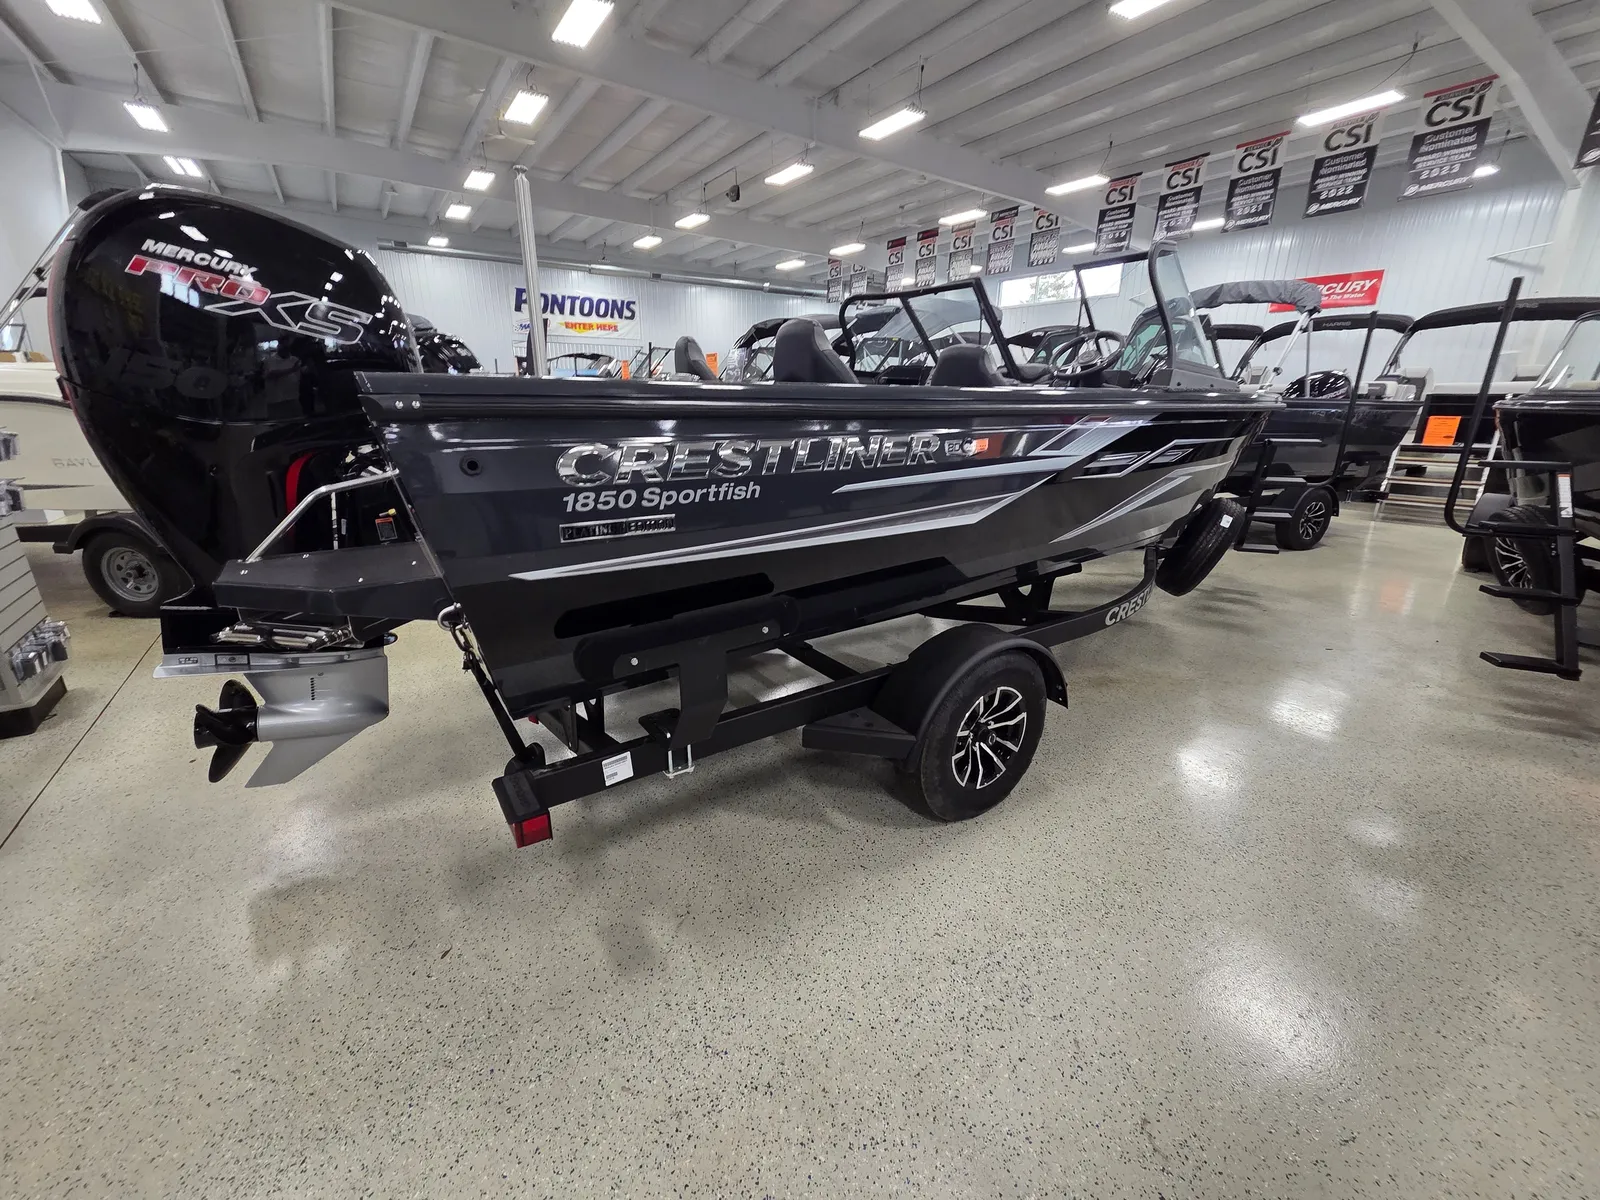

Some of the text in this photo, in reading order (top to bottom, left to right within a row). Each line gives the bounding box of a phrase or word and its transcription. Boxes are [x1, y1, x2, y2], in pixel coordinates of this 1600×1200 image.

[1424, 93, 1485, 127] CSI
[1324, 123, 1374, 152] CSI
[1419, 133, 1478, 154] Nominated
[1423, 126, 1477, 144] Customer
[1238, 146, 1279, 173] CSI
[1319, 158, 1367, 176] Nominated
[1323, 152, 1367, 168] Customer
[1167, 167, 1201, 190] CSI
[1420, 164, 1462, 180] 2023
[1419, 175, 1473, 191] MERCURY
[1105, 185, 1135, 206] CSI
[1320, 185, 1355, 200] 2022
[1236, 203, 1263, 217] 2021
[1320, 196, 1363, 210] MERCURY
[1036, 212, 1060, 231] CSI
[992, 225, 1014, 241] CSI
[918, 243, 936, 257] CSI
[953, 235, 972, 250] CSI
[141, 239, 258, 276] MERCURY
[888, 251, 904, 265] CSI
[829, 265, 842, 278] CSI
[125, 254, 374, 345] PRO XS
[564, 321, 619, 332] ENTER HERE
[1322, 320, 1352, 328] HARRIS
[52, 457, 100, 469] BAYL
[555, 433, 940, 487] CRESTLINER
[563, 481, 761, 513] 1850 Sportfish
[563, 521, 626, 539] PLATIN
